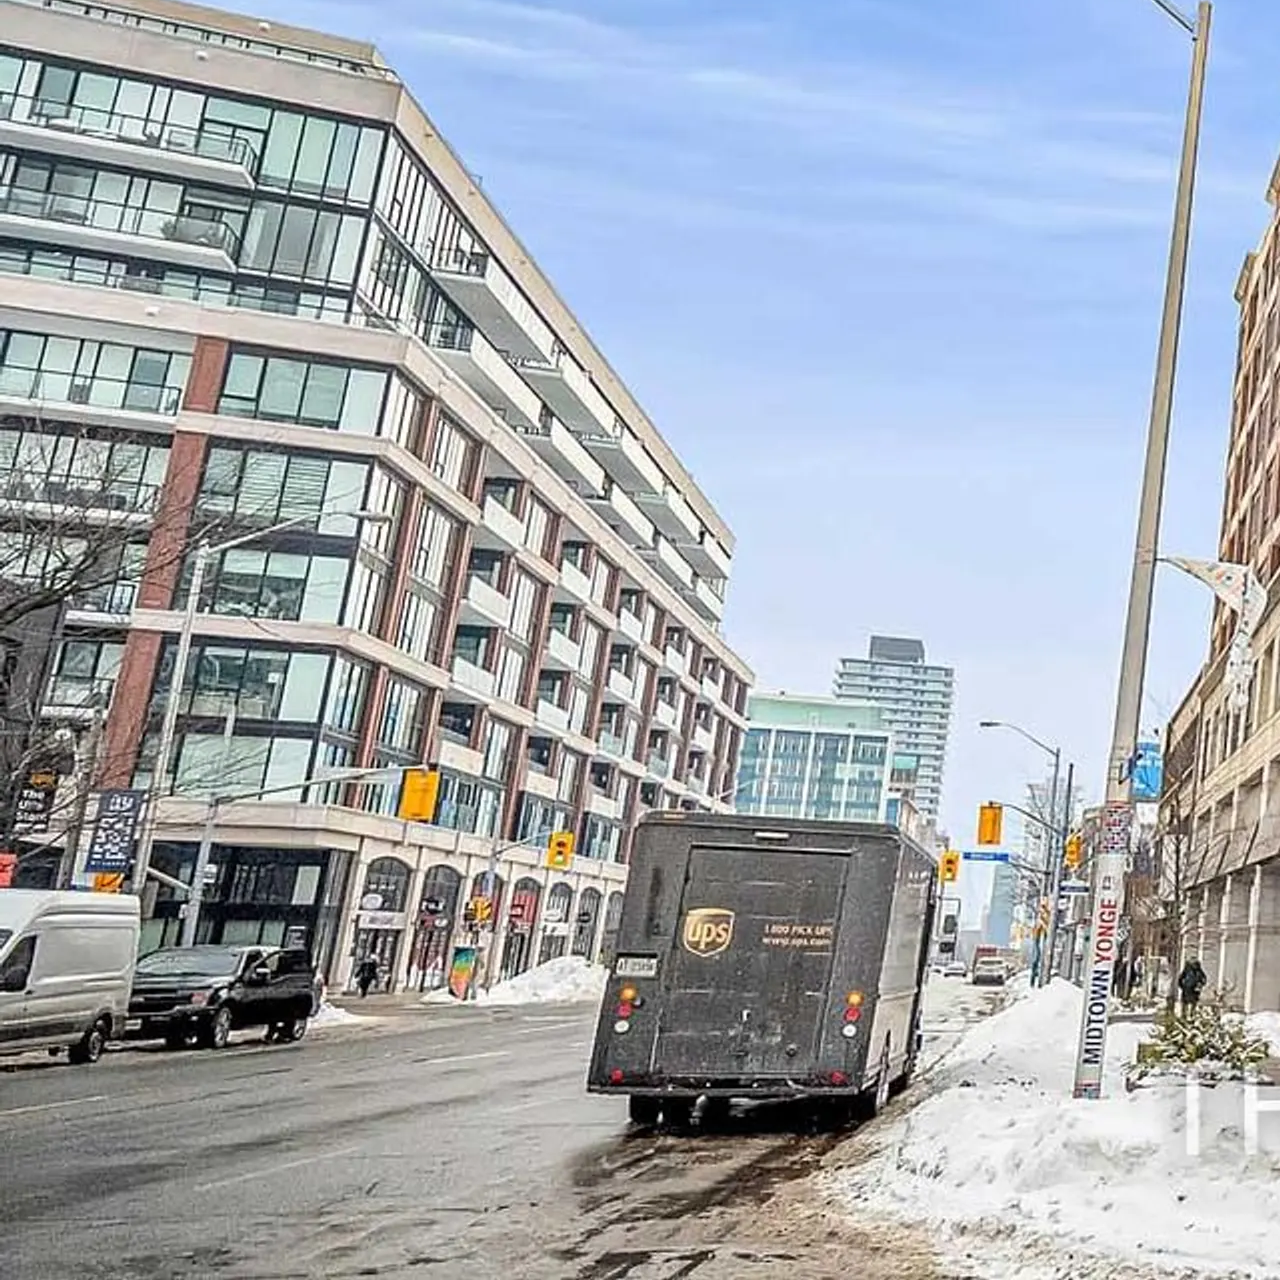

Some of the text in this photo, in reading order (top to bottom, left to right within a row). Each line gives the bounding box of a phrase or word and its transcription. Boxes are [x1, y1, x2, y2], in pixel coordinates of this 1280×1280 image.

[687, 921, 730, 950] ups
[1082, 897, 1118, 1066] MIDTOWN YONGE
